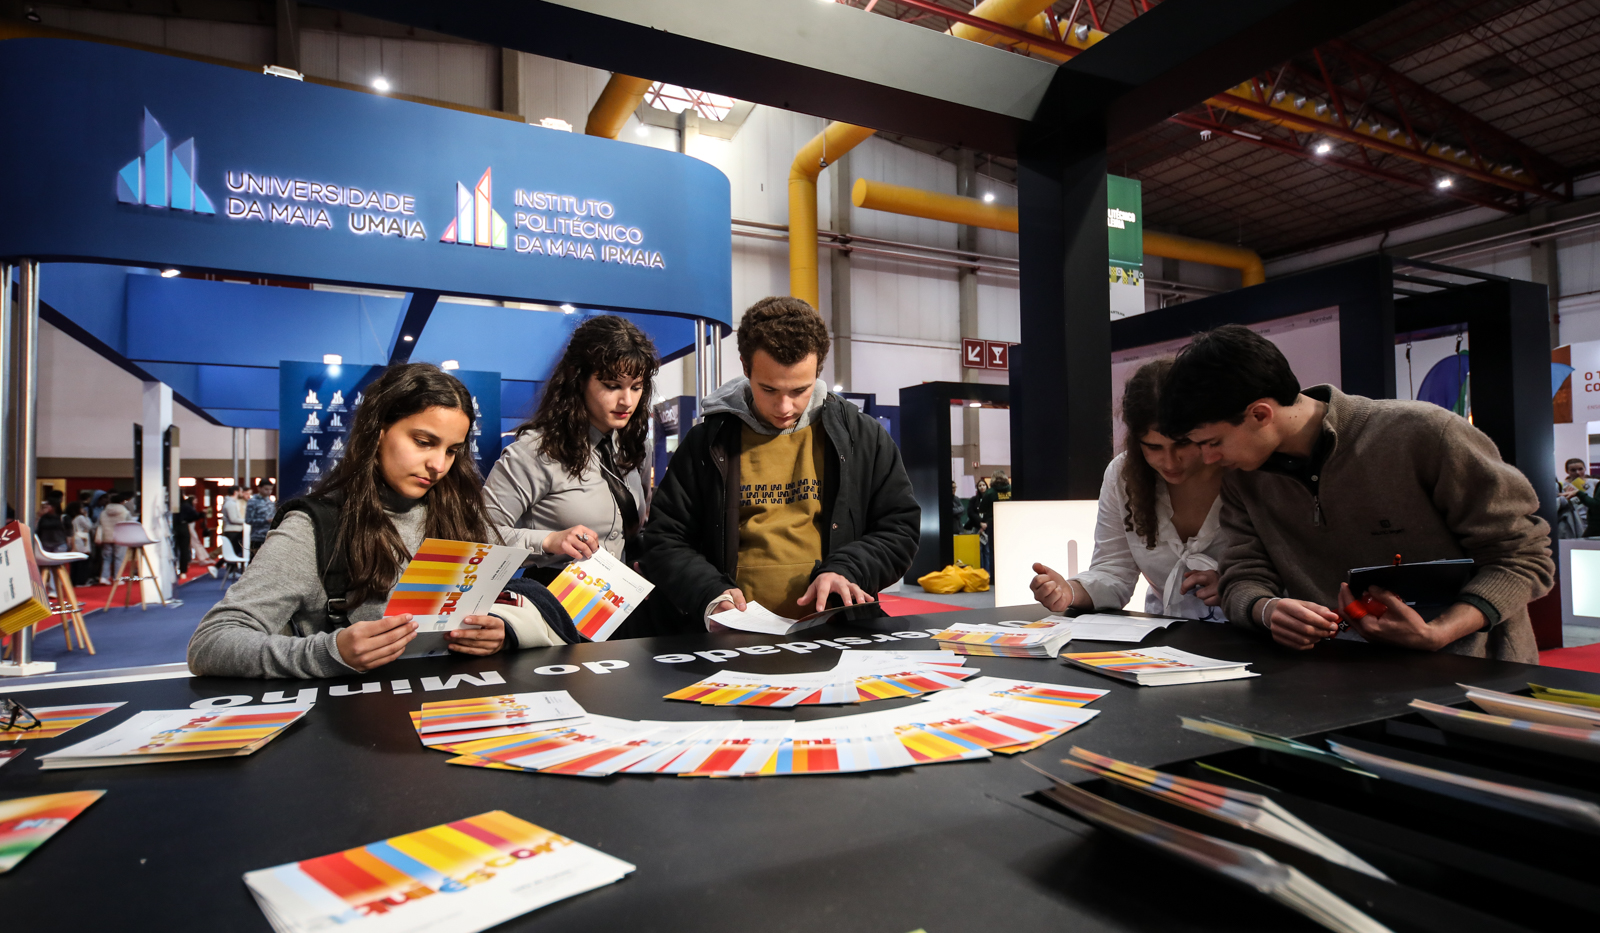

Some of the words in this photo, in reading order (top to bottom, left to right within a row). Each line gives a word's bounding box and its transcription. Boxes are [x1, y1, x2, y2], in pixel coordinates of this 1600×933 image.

[226, 170, 415, 214] UNIVERSIDADE
[515, 189, 614, 219] INSTITUTO
[227, 197, 264, 220] DA
[269, 202, 333, 229] MAIA
[349, 212, 428, 241] UMAIA
[515, 212, 643, 244] POLITÉCNICO
[515, 234, 544, 255] DA
[548, 238, 596, 261] MAIA
[601, 245, 665, 269] IPMAIA
[1584, 371, 1593, 381] O
[1584, 382, 1600, 393] CO
[533, 659, 630, 675] do
[190, 670, 506, 709] Minho
